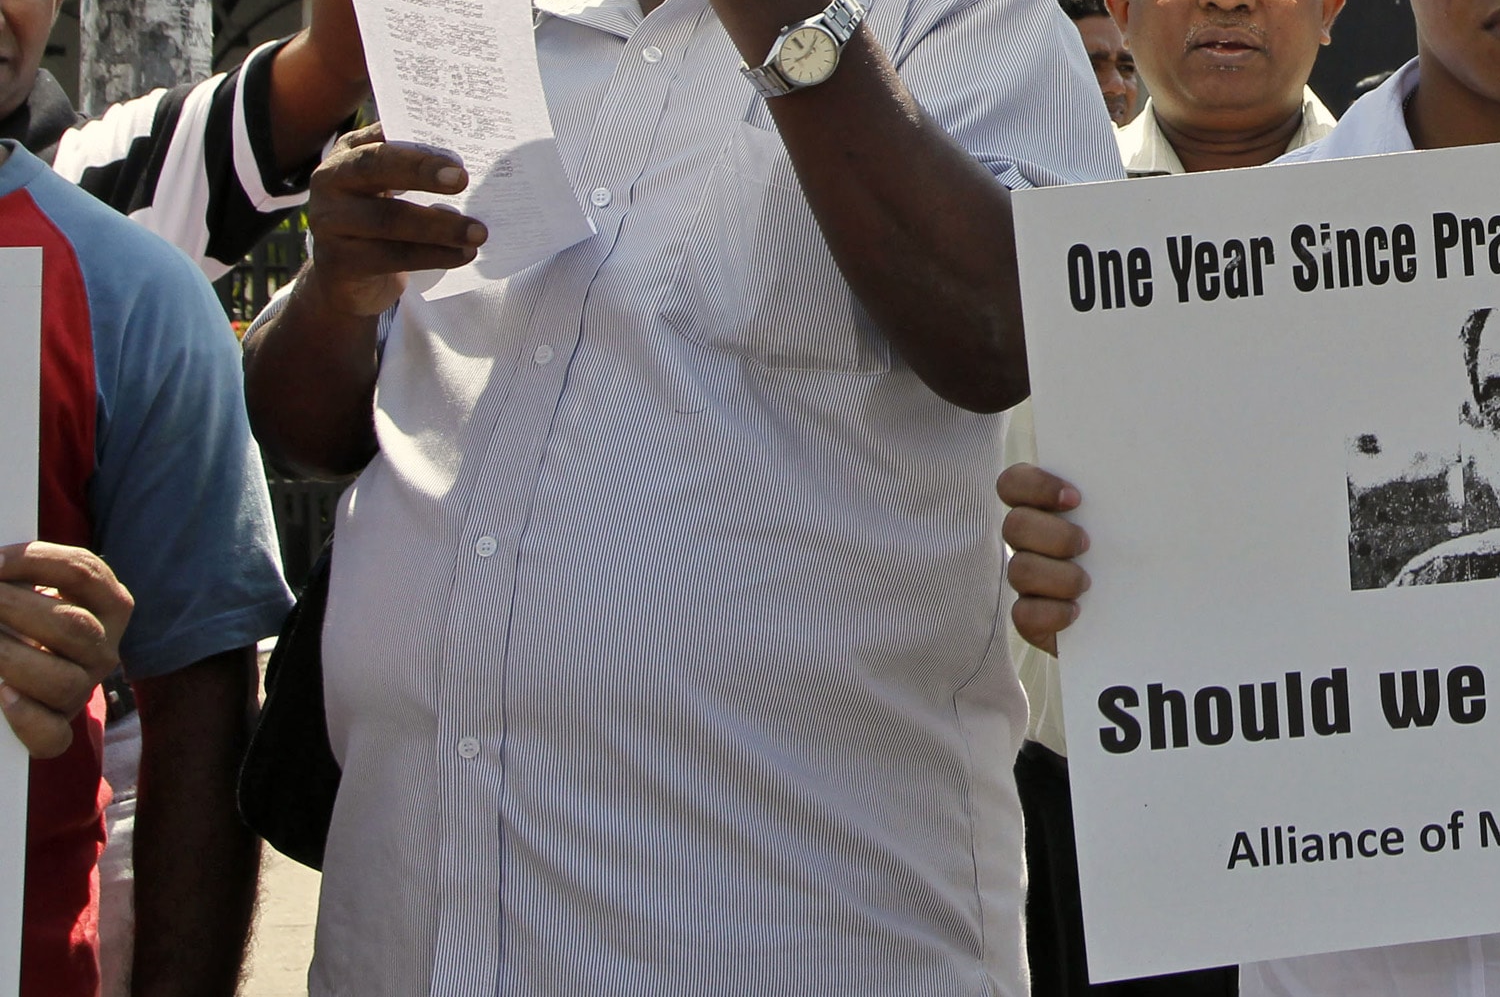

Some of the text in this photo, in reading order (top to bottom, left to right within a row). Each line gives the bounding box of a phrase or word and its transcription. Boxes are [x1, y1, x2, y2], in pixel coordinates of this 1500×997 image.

[1068, 244, 1153, 312] One
[1166, 235, 1275, 303] Year
[1291, 223, 1417, 292] Since
[1098, 668, 1350, 754] Should
[1379, 666, 1486, 729] we
[1227, 826, 1404, 869] Alliance
[1420, 811, 1464, 852] of
